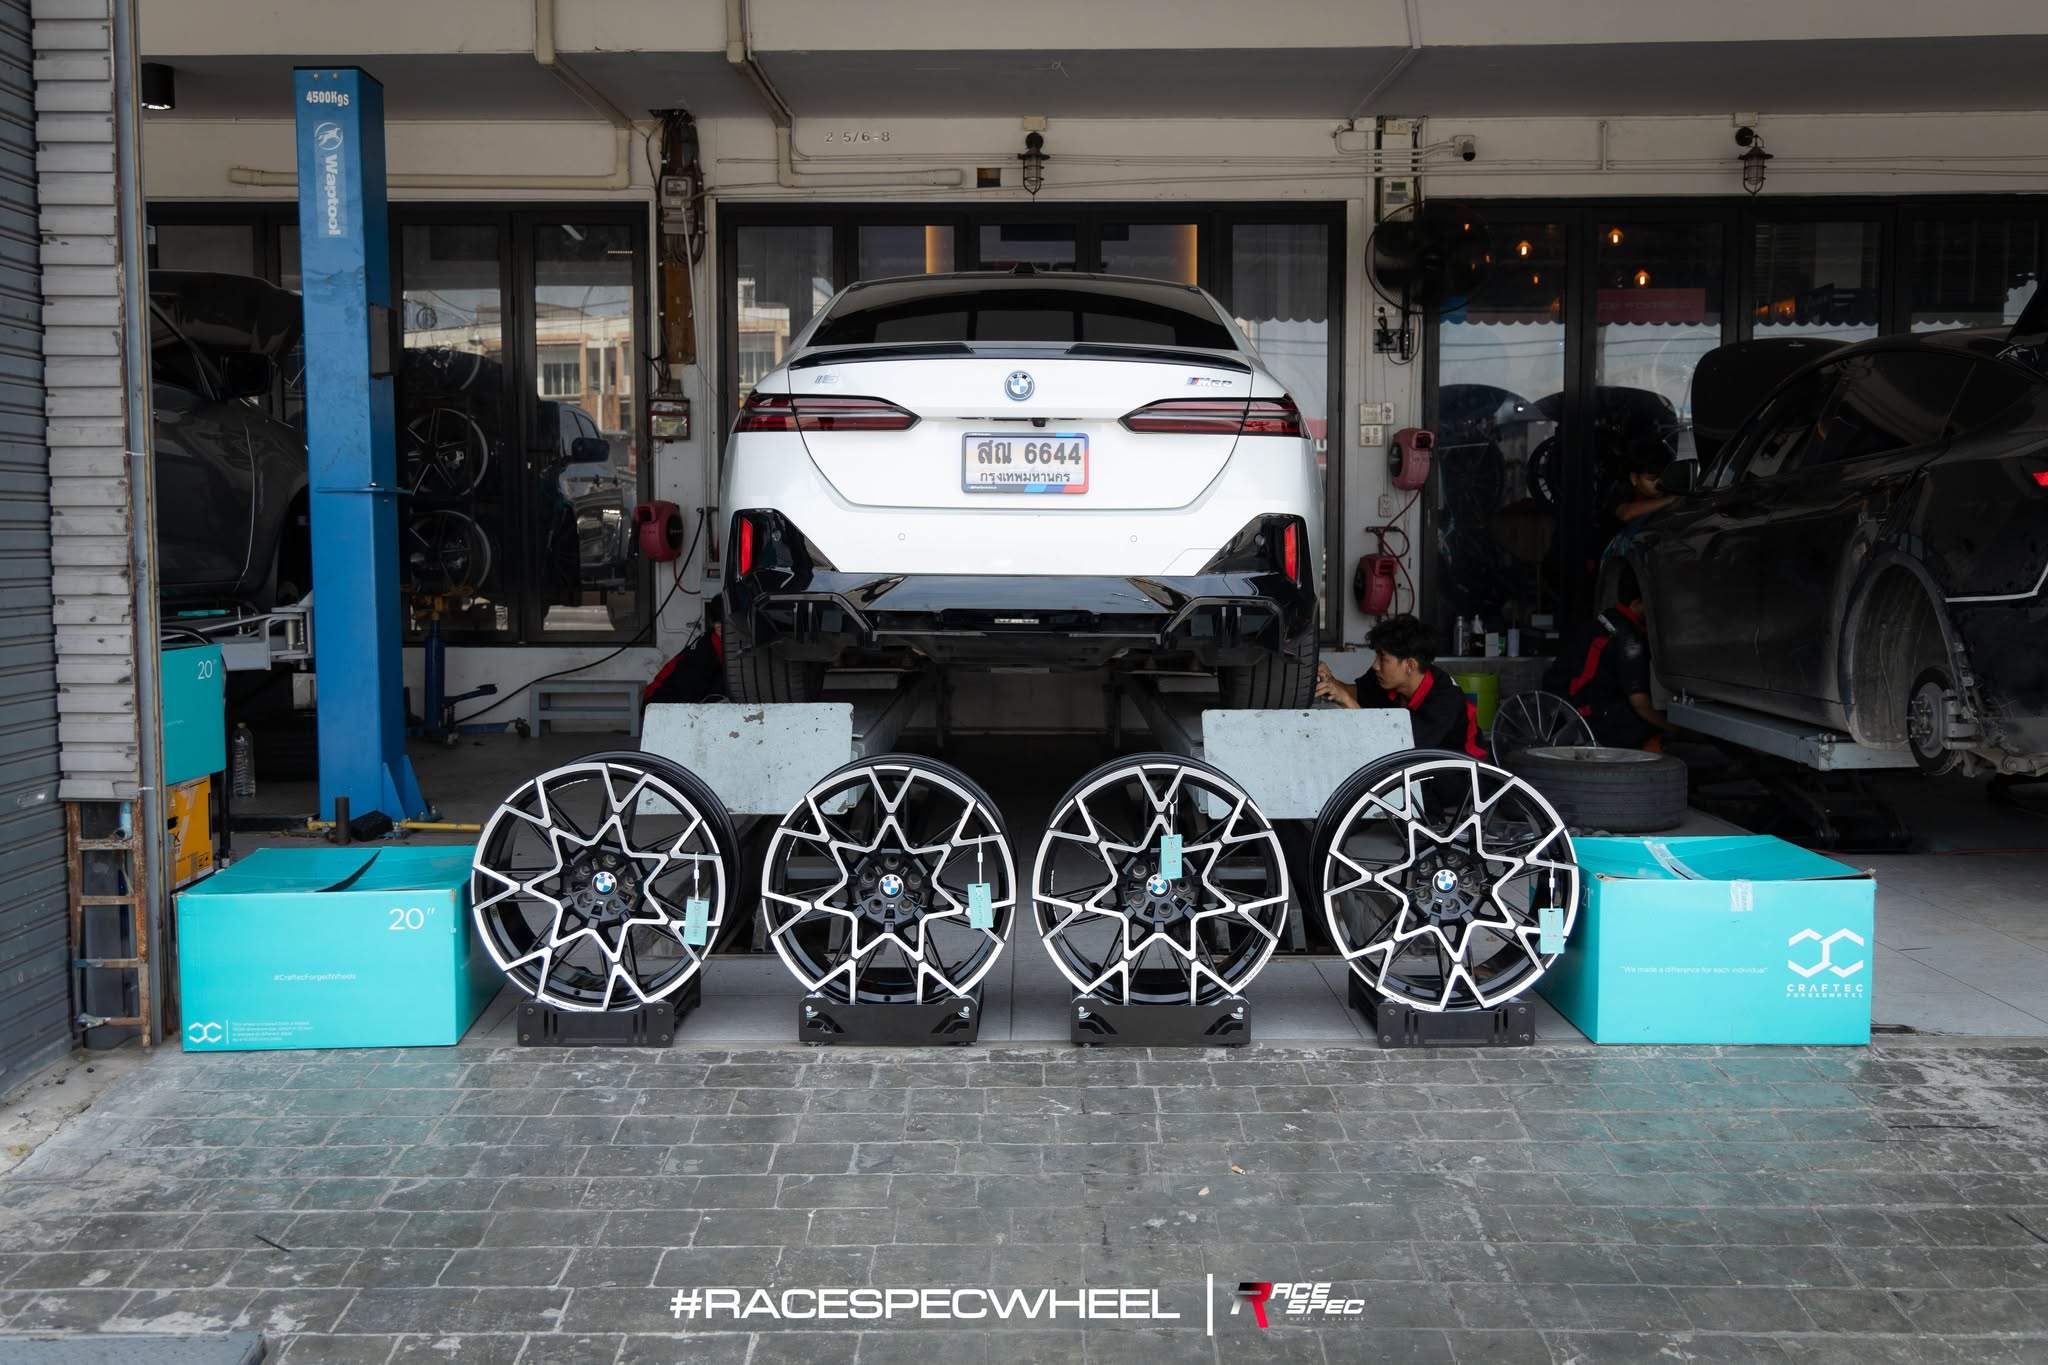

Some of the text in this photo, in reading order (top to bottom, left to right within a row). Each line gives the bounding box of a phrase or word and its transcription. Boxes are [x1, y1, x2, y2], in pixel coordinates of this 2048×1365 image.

[324, 154, 342, 236] Waptool
[1024, 442, 1081, 465] 6644
[980, 472, 1071, 485] กรุงเทพมหานคร
[388, 907, 435, 931] 20"
[1786, 983, 1864, 992] CRAFTEC
